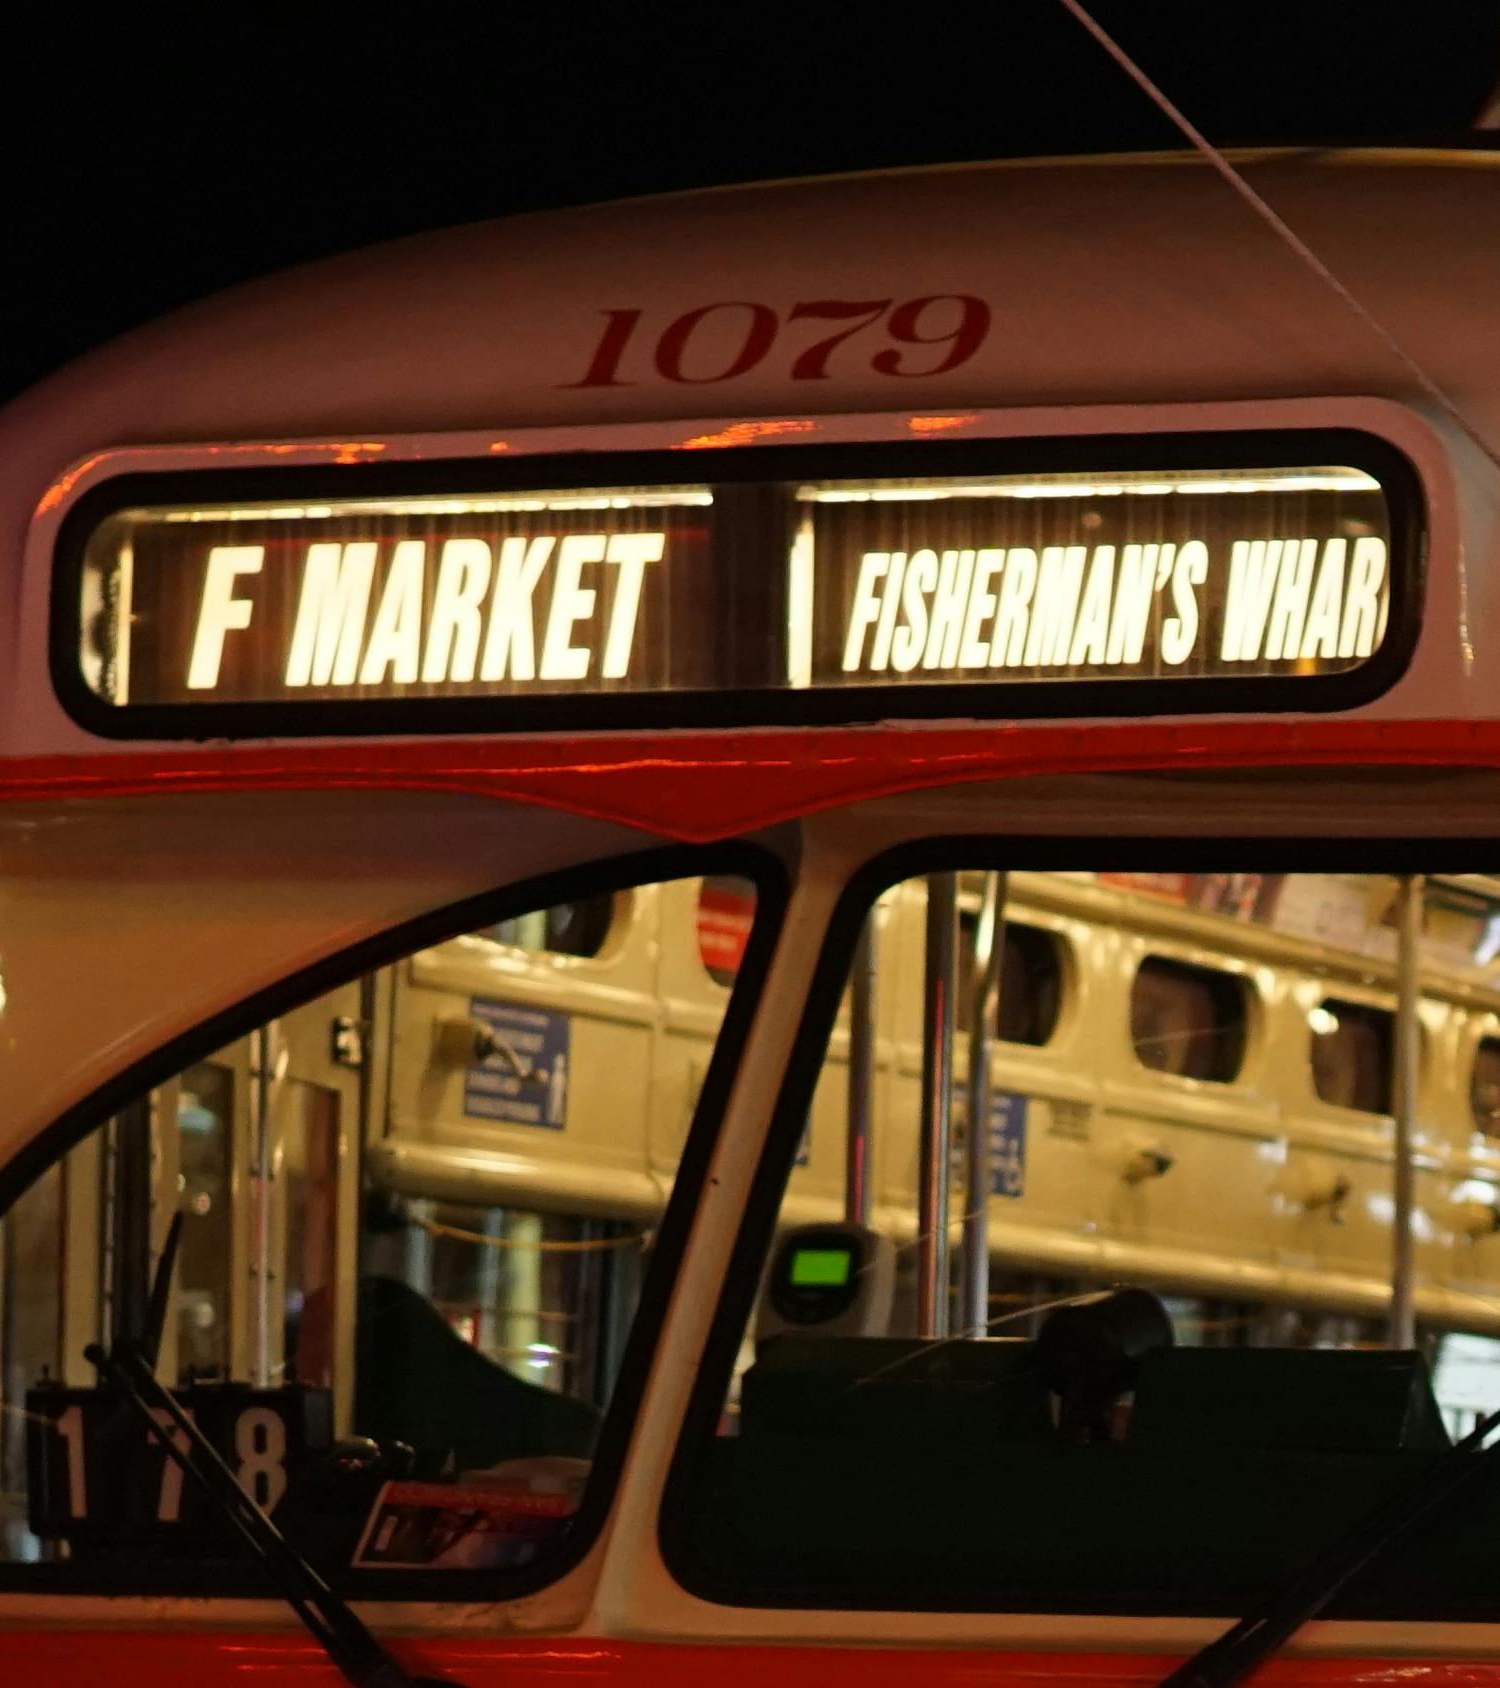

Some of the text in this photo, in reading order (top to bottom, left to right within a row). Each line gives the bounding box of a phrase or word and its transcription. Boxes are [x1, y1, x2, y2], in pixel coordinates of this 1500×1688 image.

[552, 294, 993, 389] 1079
[187, 532, 666, 690] F MARKET
[842, 540, 1209, 673] FISHERMAN'S
